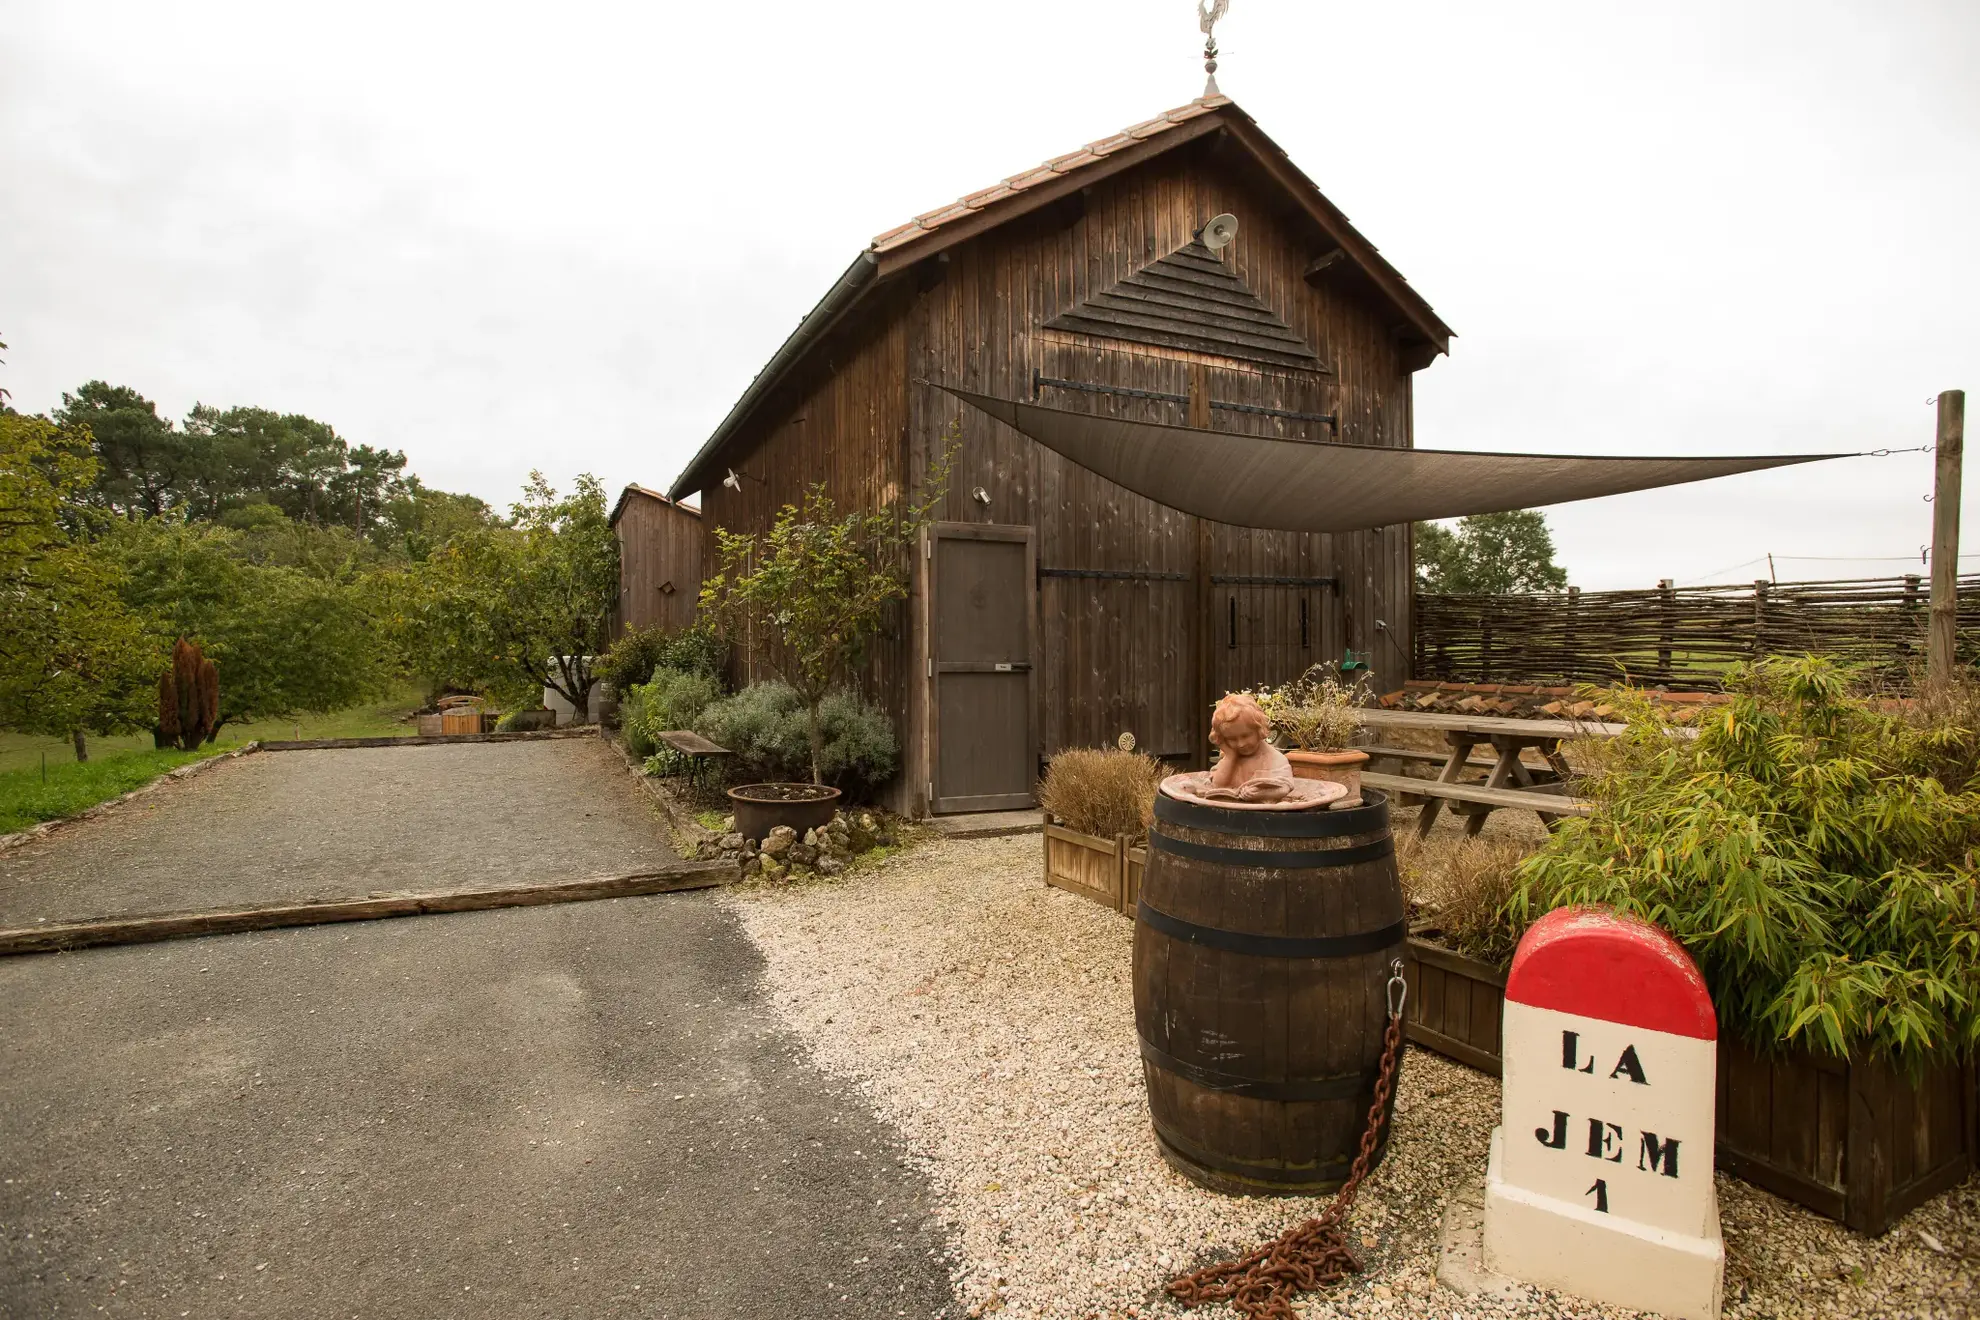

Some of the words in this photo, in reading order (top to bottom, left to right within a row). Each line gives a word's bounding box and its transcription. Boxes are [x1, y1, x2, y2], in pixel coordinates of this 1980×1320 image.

[1562, 1029, 1651, 1086] LA
[1534, 1110, 1682, 1179] JEM
[1585, 1178, 1609, 1214] 1
